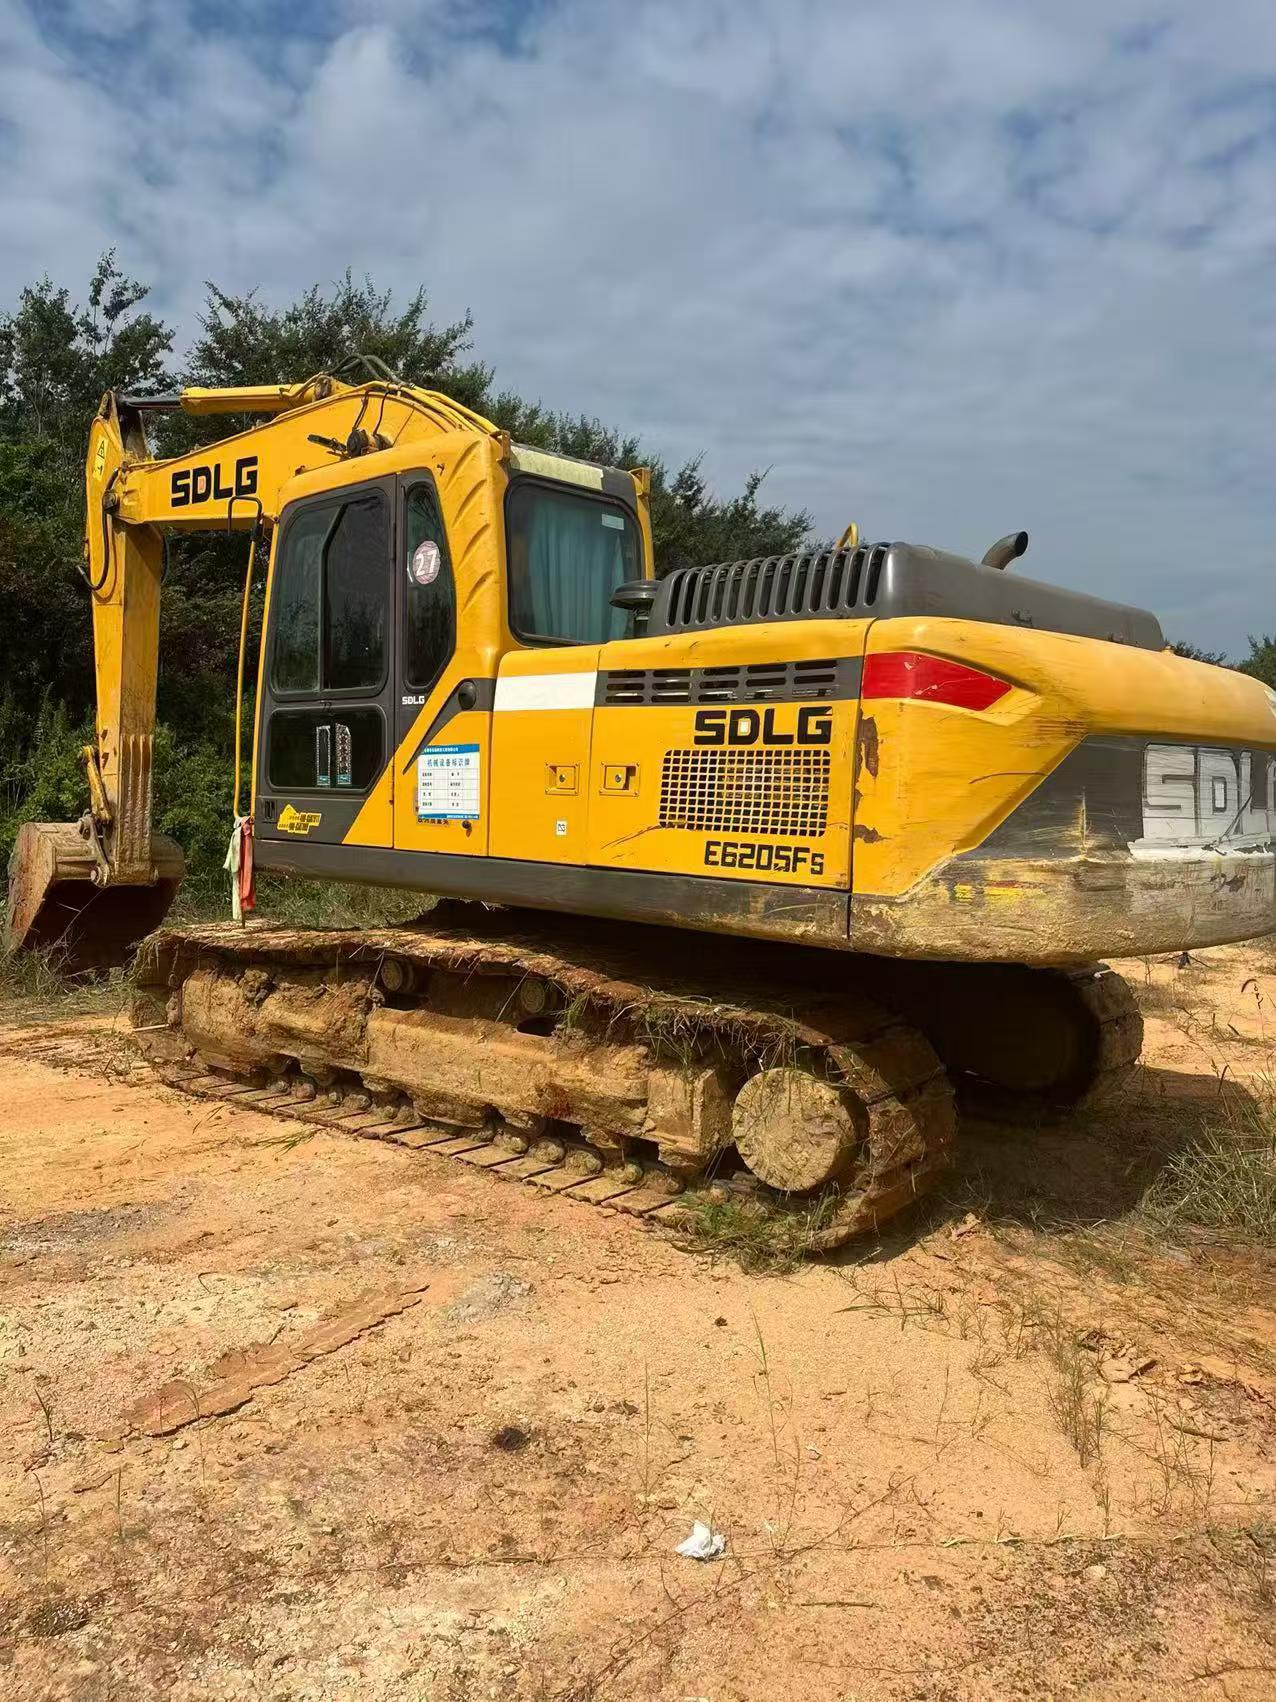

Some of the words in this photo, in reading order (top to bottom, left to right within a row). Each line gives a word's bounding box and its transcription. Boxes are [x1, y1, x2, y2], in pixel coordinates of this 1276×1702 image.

[171, 456, 258, 507] SDLG
[416, 549, 437, 576] 27
[402, 696, 425, 705] SDLG
[694, 706, 833, 745] SDLG
